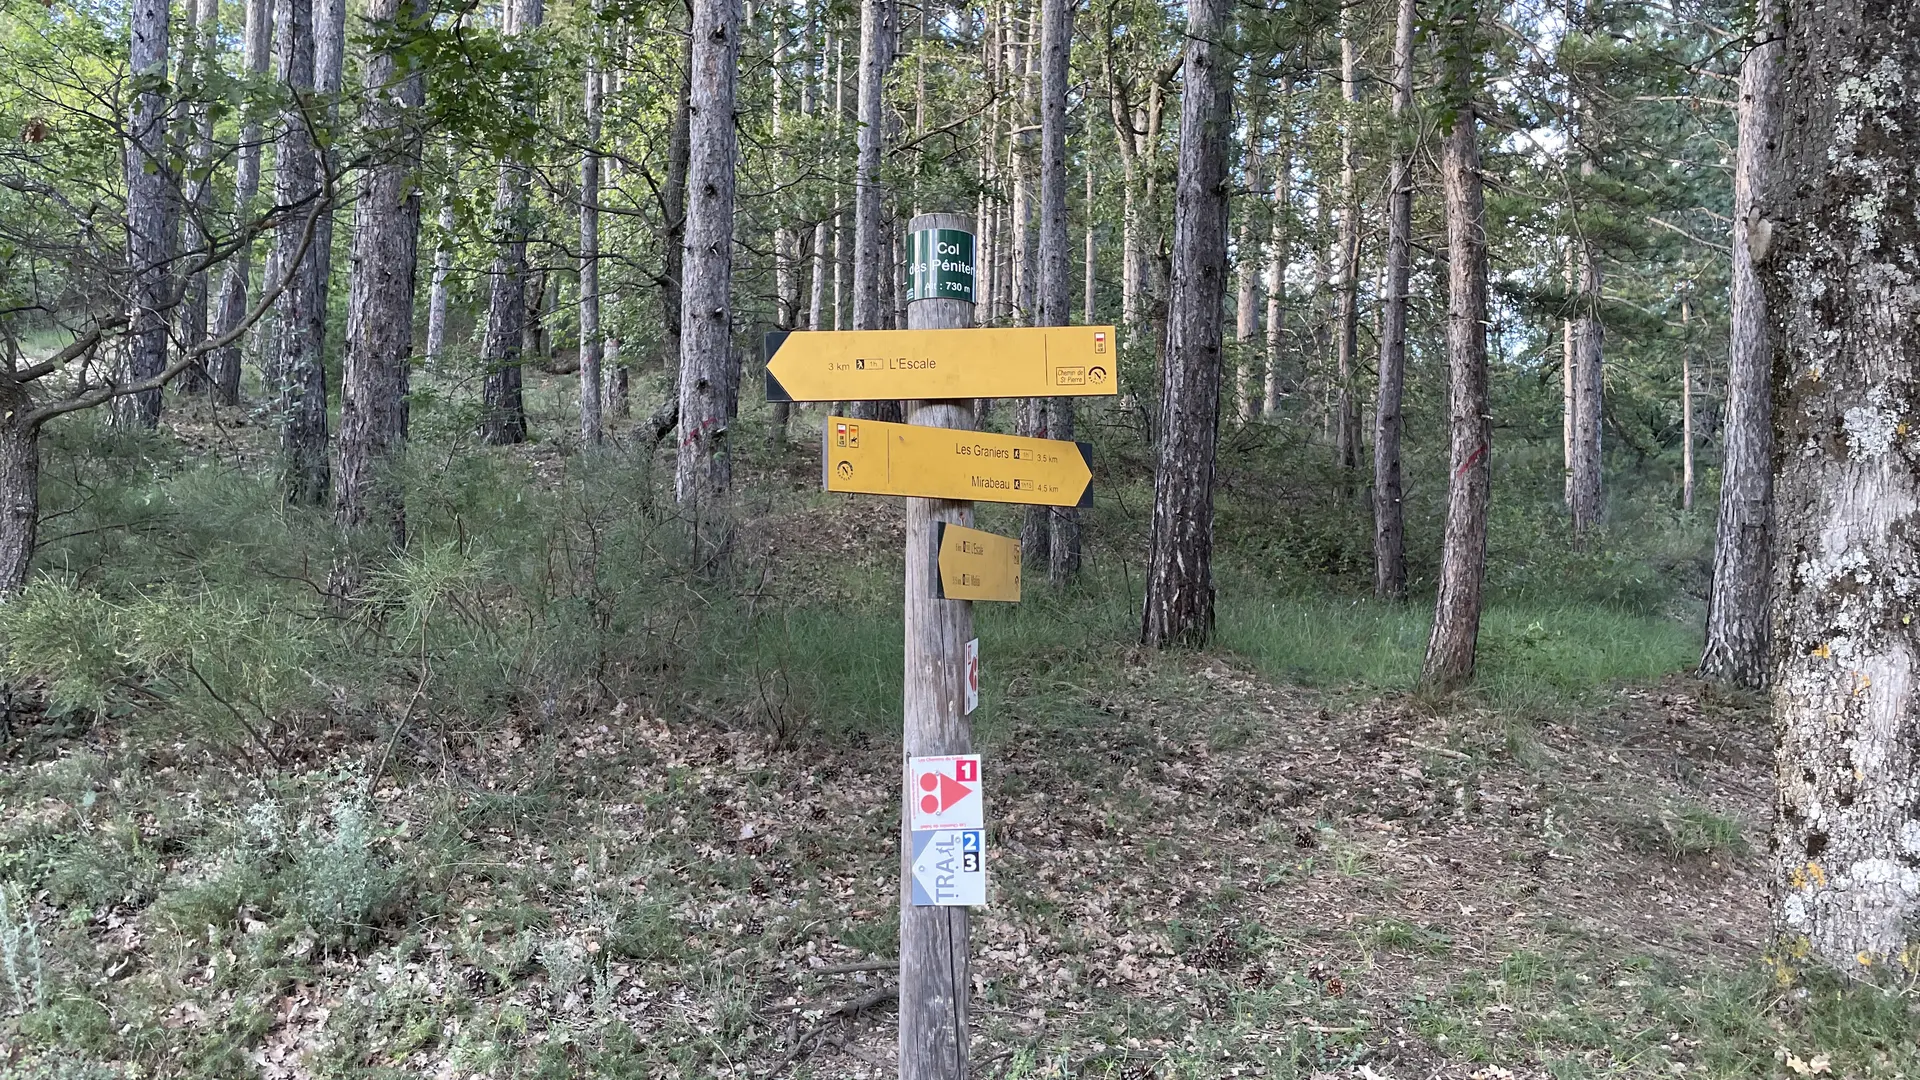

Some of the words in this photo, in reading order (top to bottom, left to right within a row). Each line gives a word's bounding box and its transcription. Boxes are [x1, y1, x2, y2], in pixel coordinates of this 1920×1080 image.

[937, 242, 960, 255] Col
[909, 262, 927, 275] des
[945, 281, 962, 291] 730
[828, 362, 834, 371] 3
[836, 362, 850, 371] km
[889, 358, 936, 369] L'Escale
[955, 443, 971, 455] Les
[973, 444, 1009, 459] Graniers
[1036, 453, 1047, 463] 3.5
[1048, 455, 1058, 463] km
[971, 475, 1010, 489] Mirabeau
[1037, 484, 1048, 493] 4.5
[1049, 484, 1059, 493] km
[961, 762, 971, 779] 1
[964, 833, 977, 851] 2
[964, 854, 977, 872] 3
